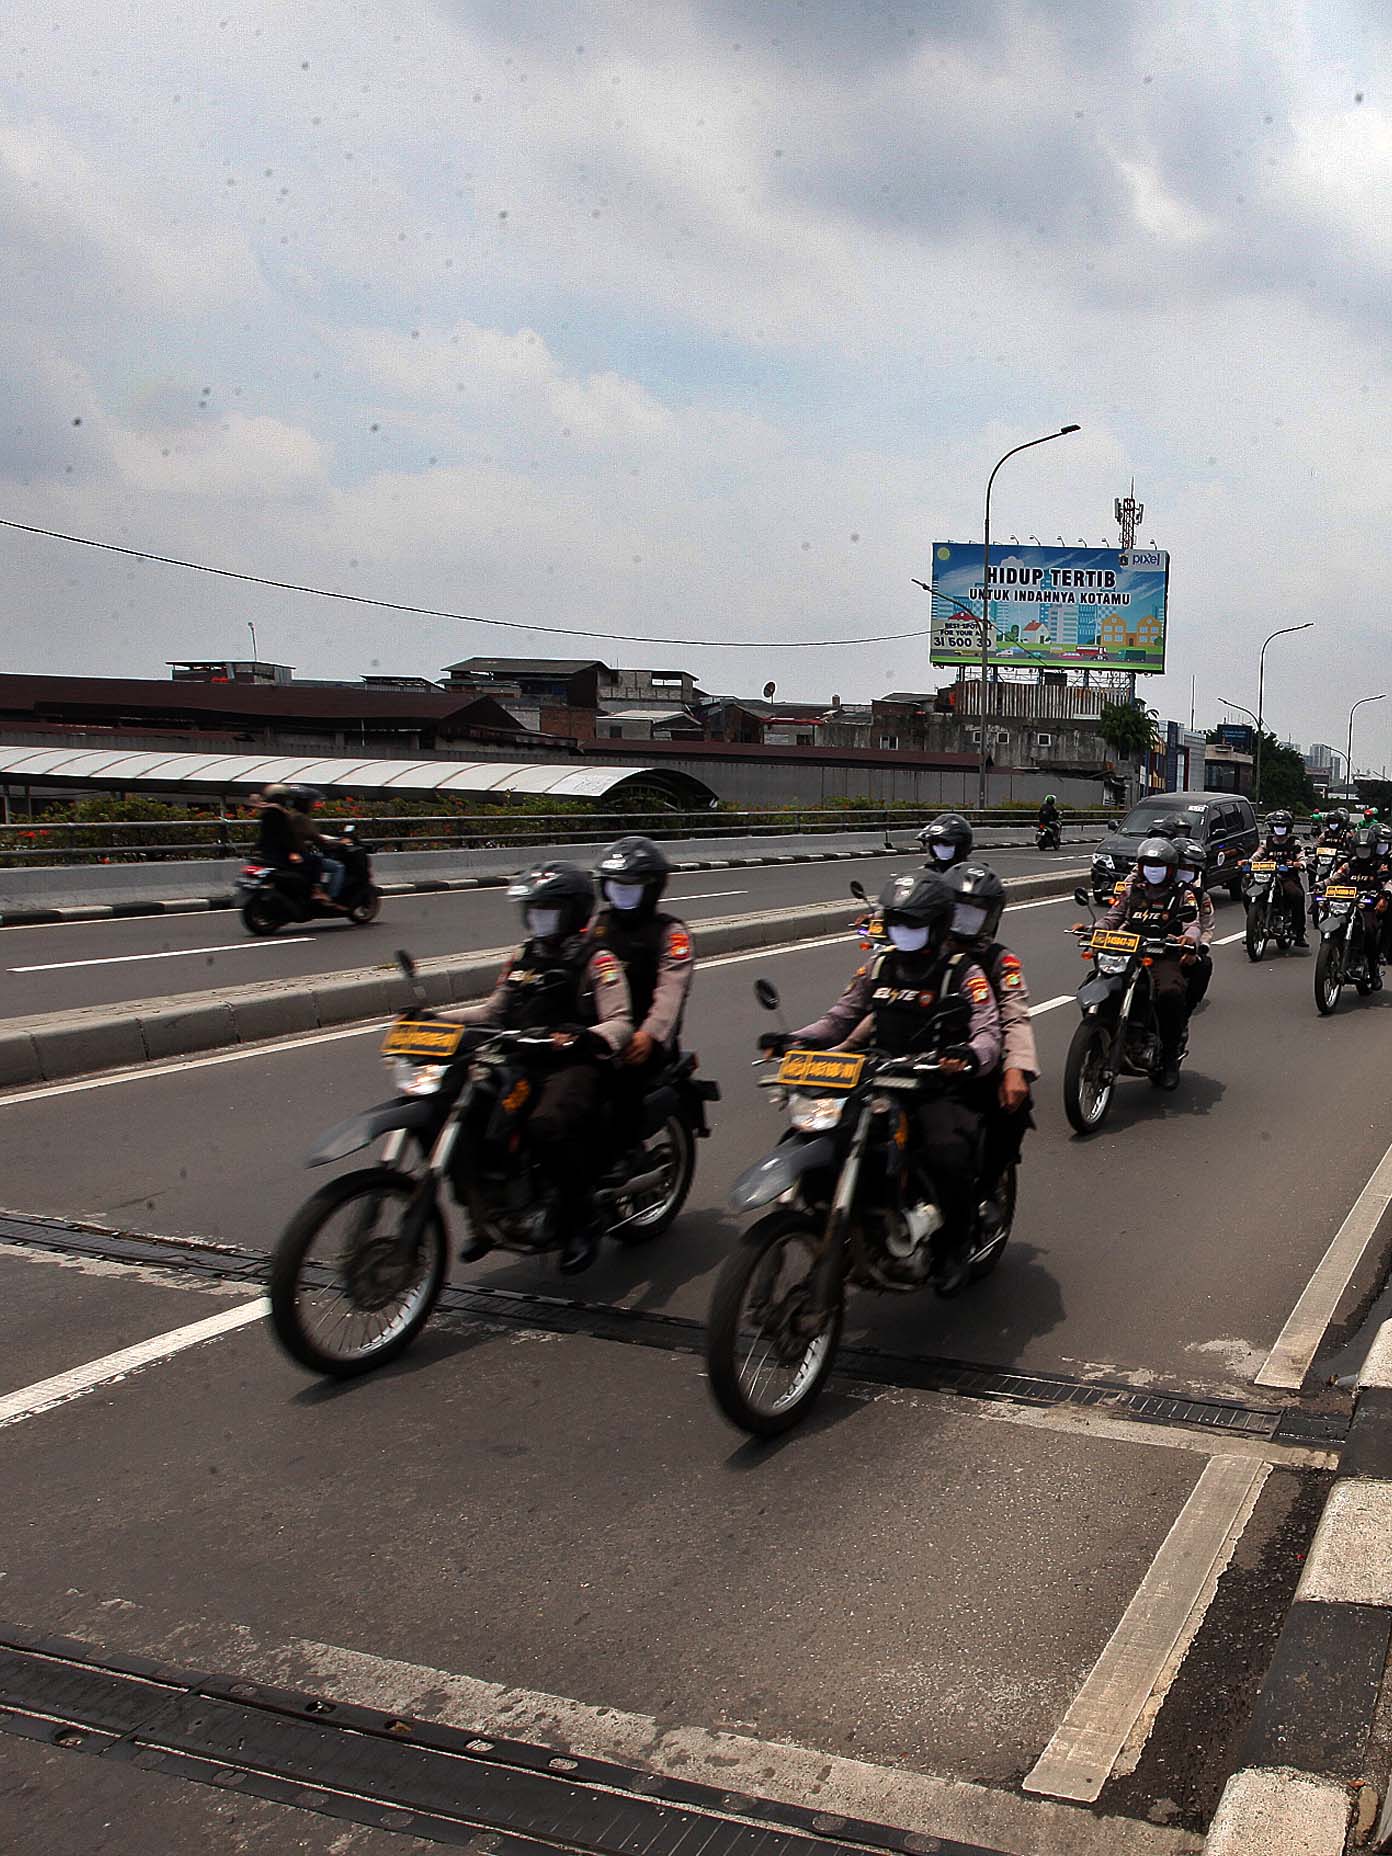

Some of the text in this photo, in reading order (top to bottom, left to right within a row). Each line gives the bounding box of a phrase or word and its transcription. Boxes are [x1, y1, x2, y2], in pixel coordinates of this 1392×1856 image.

[987, 566, 1116, 588] HIDUP TERTIB
[969, 588, 1132, 606] UNTUK INDAHNYA KOTAMU
[948, 637, 972, 648] 500
[1132, 909, 1161, 922] ELITE
[872, 986, 920, 1004] ELITE
